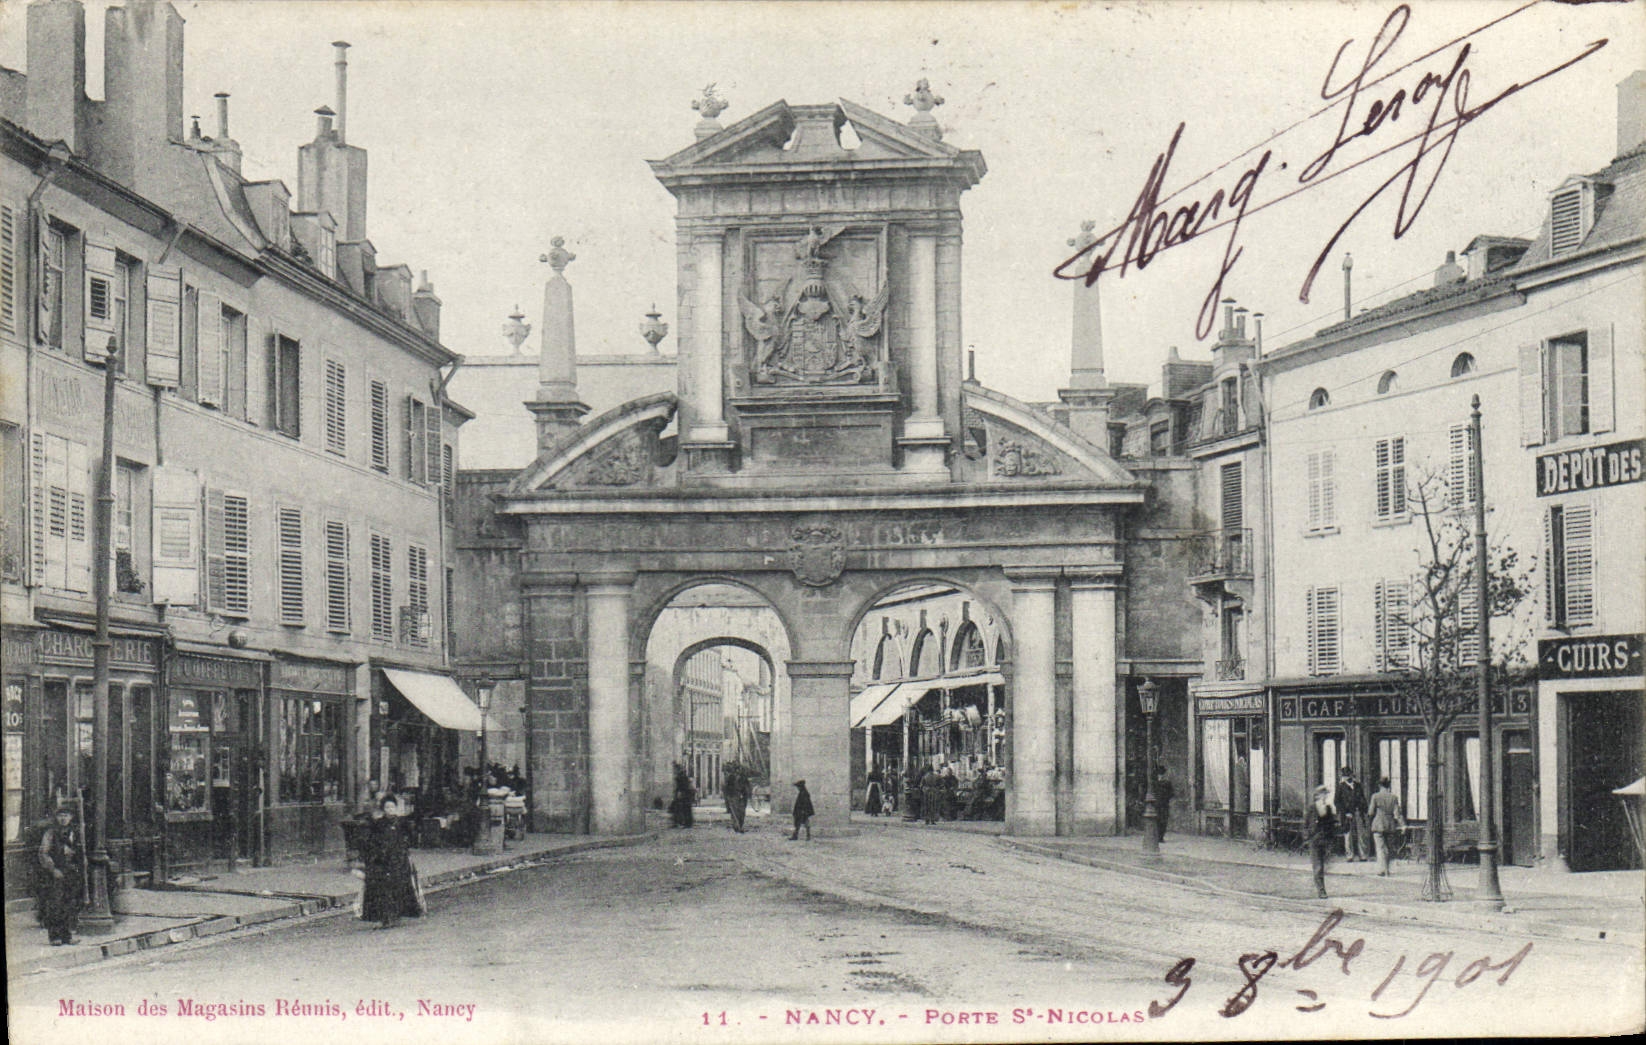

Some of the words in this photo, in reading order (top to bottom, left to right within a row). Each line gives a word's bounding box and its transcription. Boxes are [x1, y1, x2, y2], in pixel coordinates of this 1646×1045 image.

[1609, 448, 1641, 482] DES
[1557, 641, 1628, 672] CUIRS
[1284, 701, 1292, 717] 3
[1517, 694, 1527, 711] 3
[1368, 942, 1533, 1019] 1901
